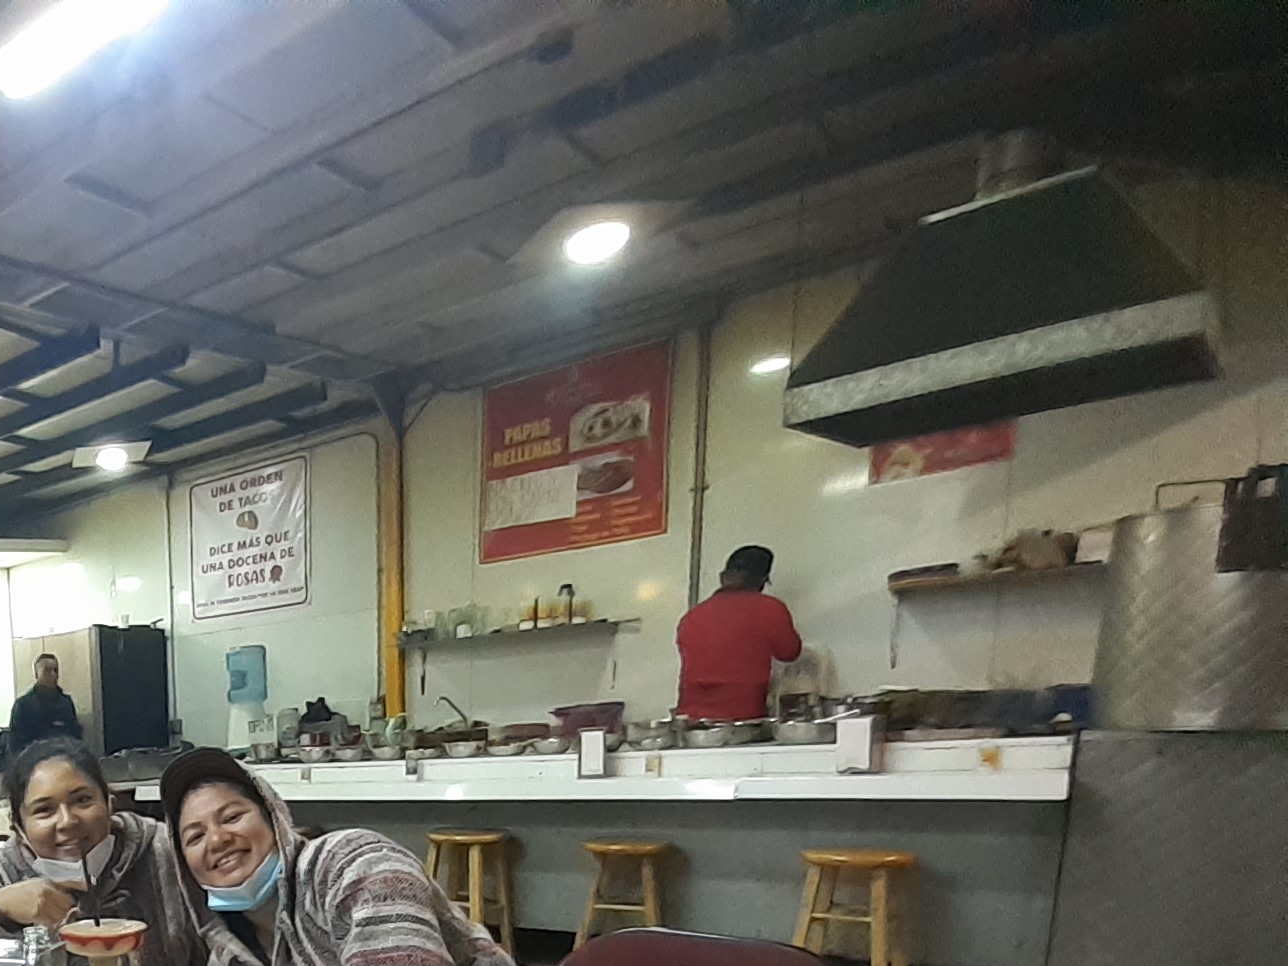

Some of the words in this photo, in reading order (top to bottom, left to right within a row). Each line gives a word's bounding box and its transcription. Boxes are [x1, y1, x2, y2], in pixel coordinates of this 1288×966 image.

[504, 417, 552, 445] PAPAS
[492, 438, 562, 467] RELLENAS
[211, 482, 236, 498] UNA
[239, 470, 284, 491] ORDEN
[219, 499, 234, 513] DE
[209, 542, 234, 557] DICE
[264, 530, 291, 547] QUE
[202, 561, 225, 574] UNA
[228, 551, 276, 570] DOCENA
[279, 546, 295, 560] DE
[227, 569, 266, 588] ROSAS
